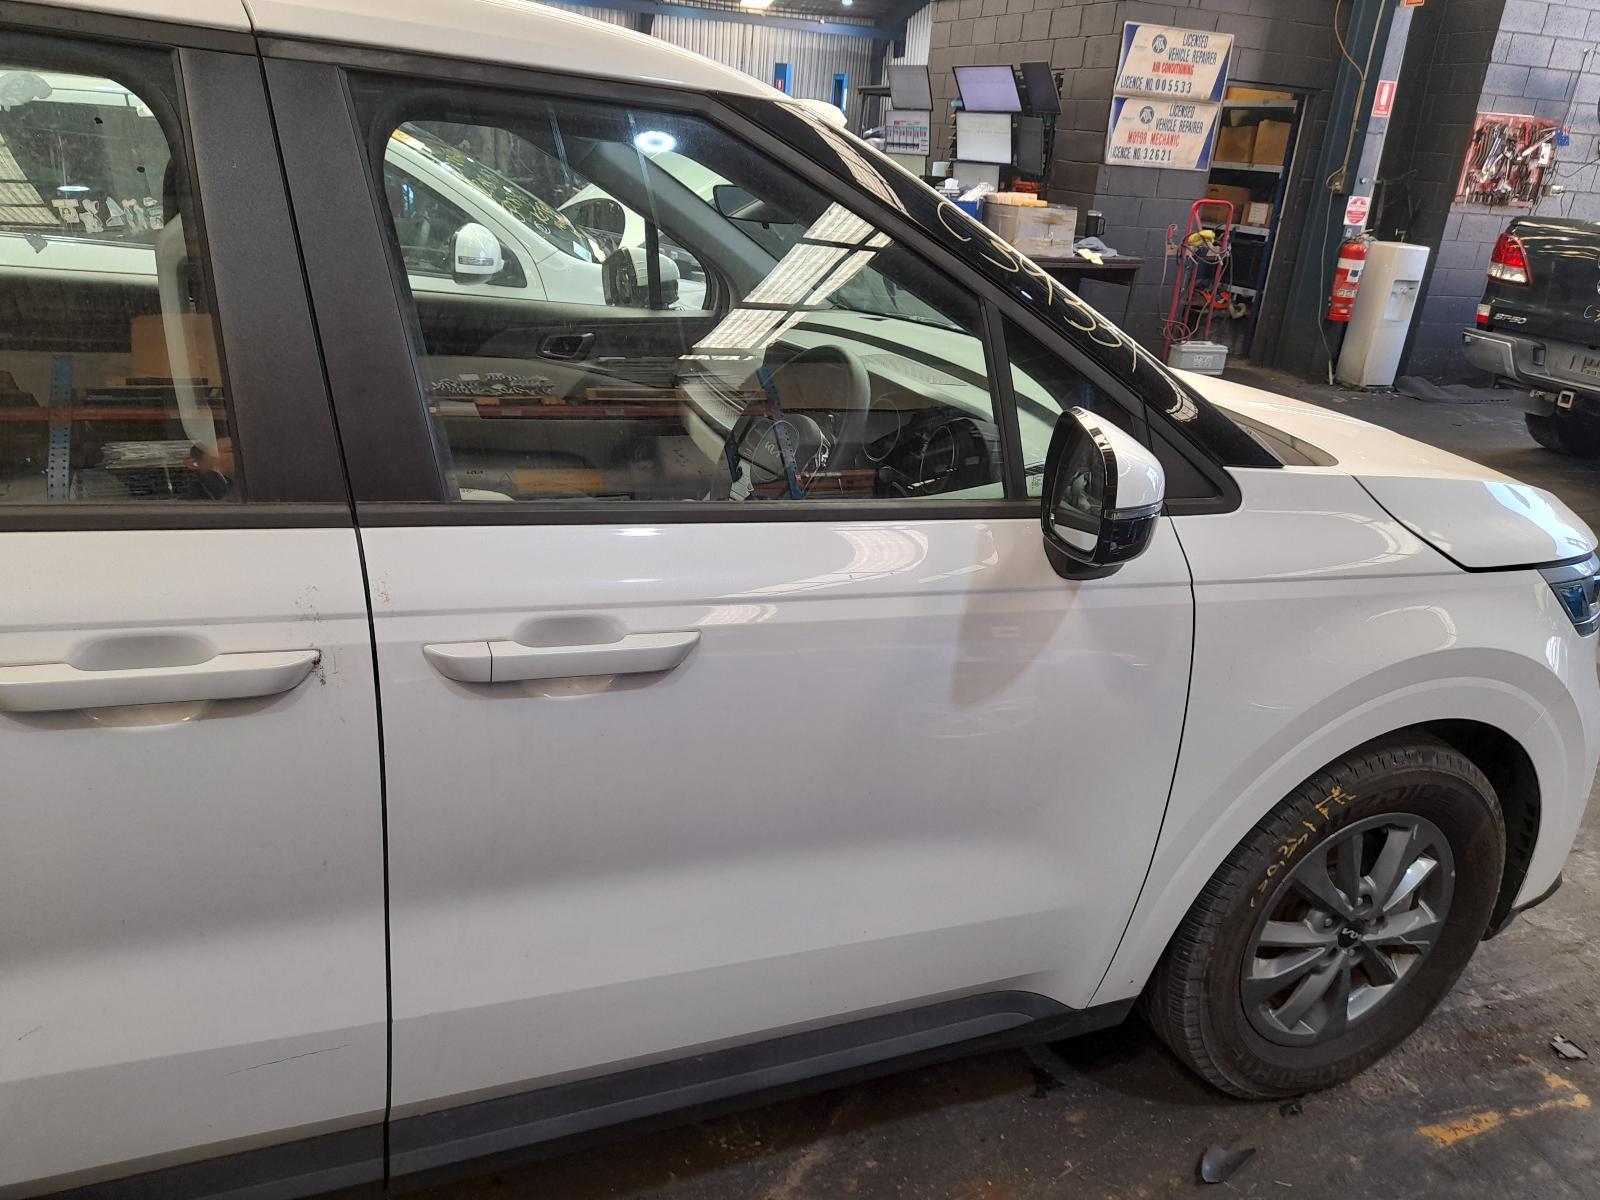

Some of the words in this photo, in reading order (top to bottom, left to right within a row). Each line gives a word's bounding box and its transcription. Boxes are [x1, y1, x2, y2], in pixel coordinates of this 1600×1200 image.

[1183, 33, 1209, 48] LICENSED
[1168, 49, 1190, 63] VEHICLE
[1192, 52, 1218, 65] REPAIRER
[1161, 62, 1195, 76] CONDITIONING
[1120, 76, 1143, 91] LICENCE
[1155, 81, 1192, 94] 005533
[1168, 104, 1196, 119] LICENSED
[1155, 117, 1177, 132] VEHICLE
[1179, 120, 1204, 135] REPAIRER
[1127, 131, 1147, 145] MOTOR
[1150, 133, 1180, 147] MECHANIC
[1143, 150, 1172, 163] 32621
